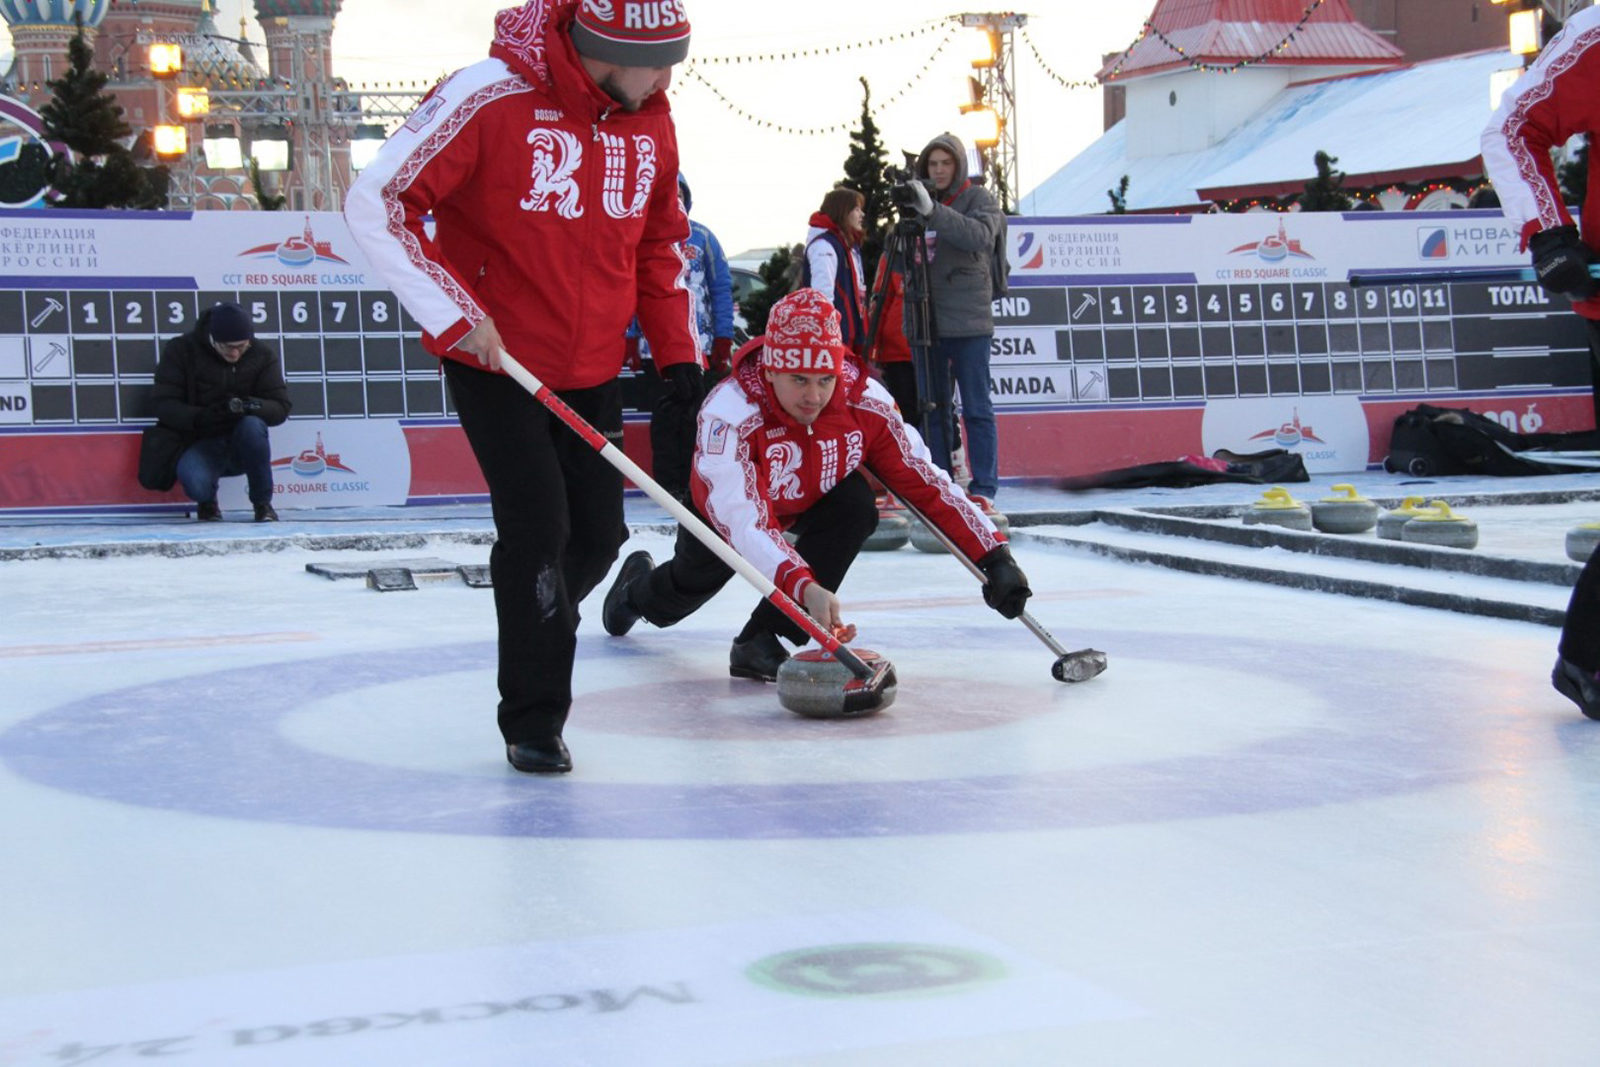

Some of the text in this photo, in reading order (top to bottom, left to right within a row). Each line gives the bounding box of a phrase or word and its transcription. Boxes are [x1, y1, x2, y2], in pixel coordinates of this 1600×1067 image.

[624, 1, 687, 29] RUSS
[0, 227, 96, 240] ФЕДЕРАЦИЯ
[1048, 232, 1119, 243] ФЕДЕРАЦИЯ
[3, 255, 98, 267] РОССИИ
[1050, 256, 1121, 268] РОССИИ
[1215, 267, 1328, 279] CCT RED SQUARE CLASSIC
[222, 274, 365, 286] CCT RED SQUARE CLASSIC
[988, 286, 1549, 317] END 1 2 3 4 5 6 7 8 9 10 11 TOTAL
[83, 301, 388, 323] 1 2 3 5 6 7 8
[990, 338, 1036, 355] SSIA
[764, 348, 835, 369] USSIA
[989, 376, 1056, 395] ANADA
[1306, 450, 1337, 460] CLASSIC
[287, 483, 328, 494] SQUARE
[331, 481, 370, 492] CLASSIC
